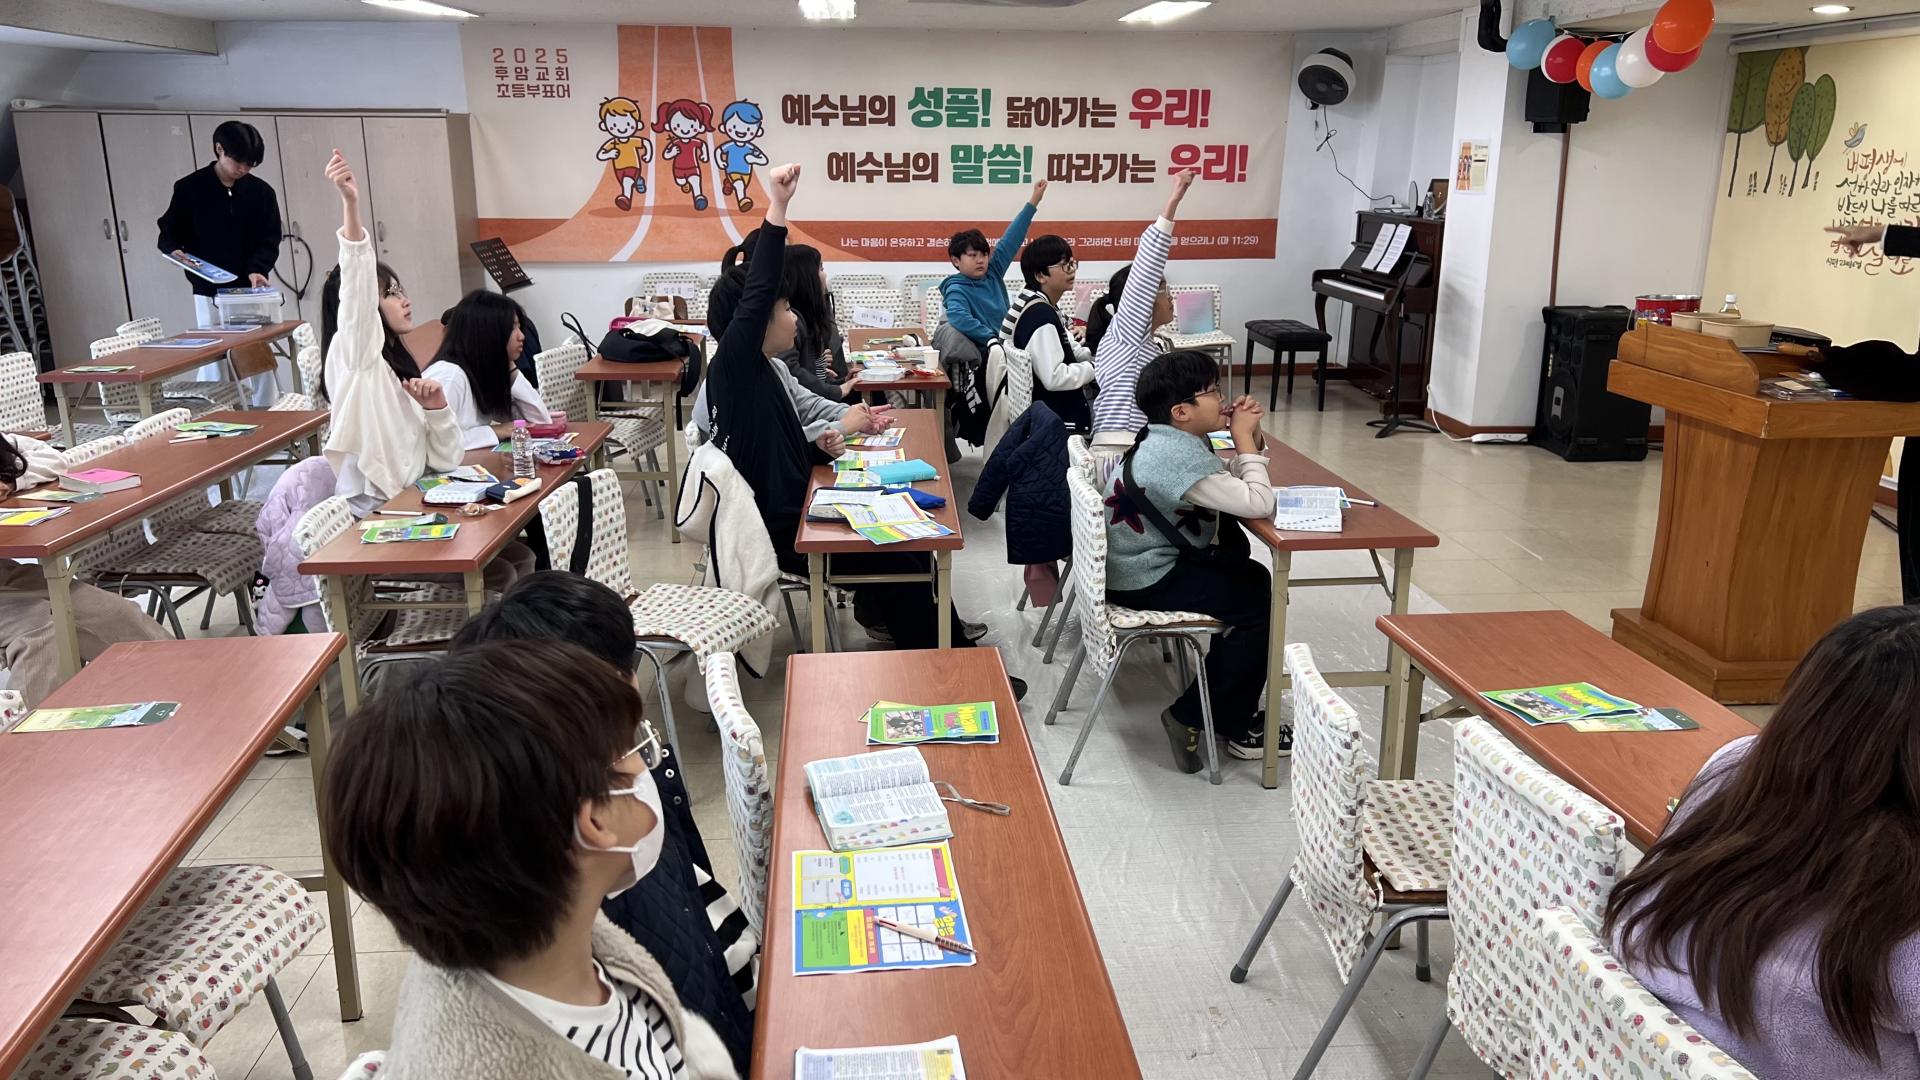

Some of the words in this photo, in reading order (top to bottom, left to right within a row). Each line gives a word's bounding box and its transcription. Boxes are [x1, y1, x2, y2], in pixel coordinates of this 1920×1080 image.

[492, 47, 568, 64] 2025
[494, 66, 570, 81] 후암교회
[496, 83, 571, 98] 초등부표어
[781, 93, 896, 127] 예수님의
[907, 86, 992, 128] 성품!
[1006, 96, 1118, 129] 닮아가는
[1128, 88, 1211, 129] 우리!
[827, 151, 939, 184] 예수님의
[950, 143, 1034, 185] 말씀!
[1047, 151, 1157, 184] 따라가는
[1167, 143, 1249, 183] 우리!
[840, 237, 859, 248] 나는
[861, 237, 888, 248] 마음이
[890, 237, 925, 248] 온유하고
[926, 237, 952, 248] 겸손하
[1077, 237, 1113, 247] 그리하면
[1114, 237, 1132, 247] 너희
[1180, 235, 1215, 246] 얻으리니
[1231, 235, 1259, 246] 11:29)
